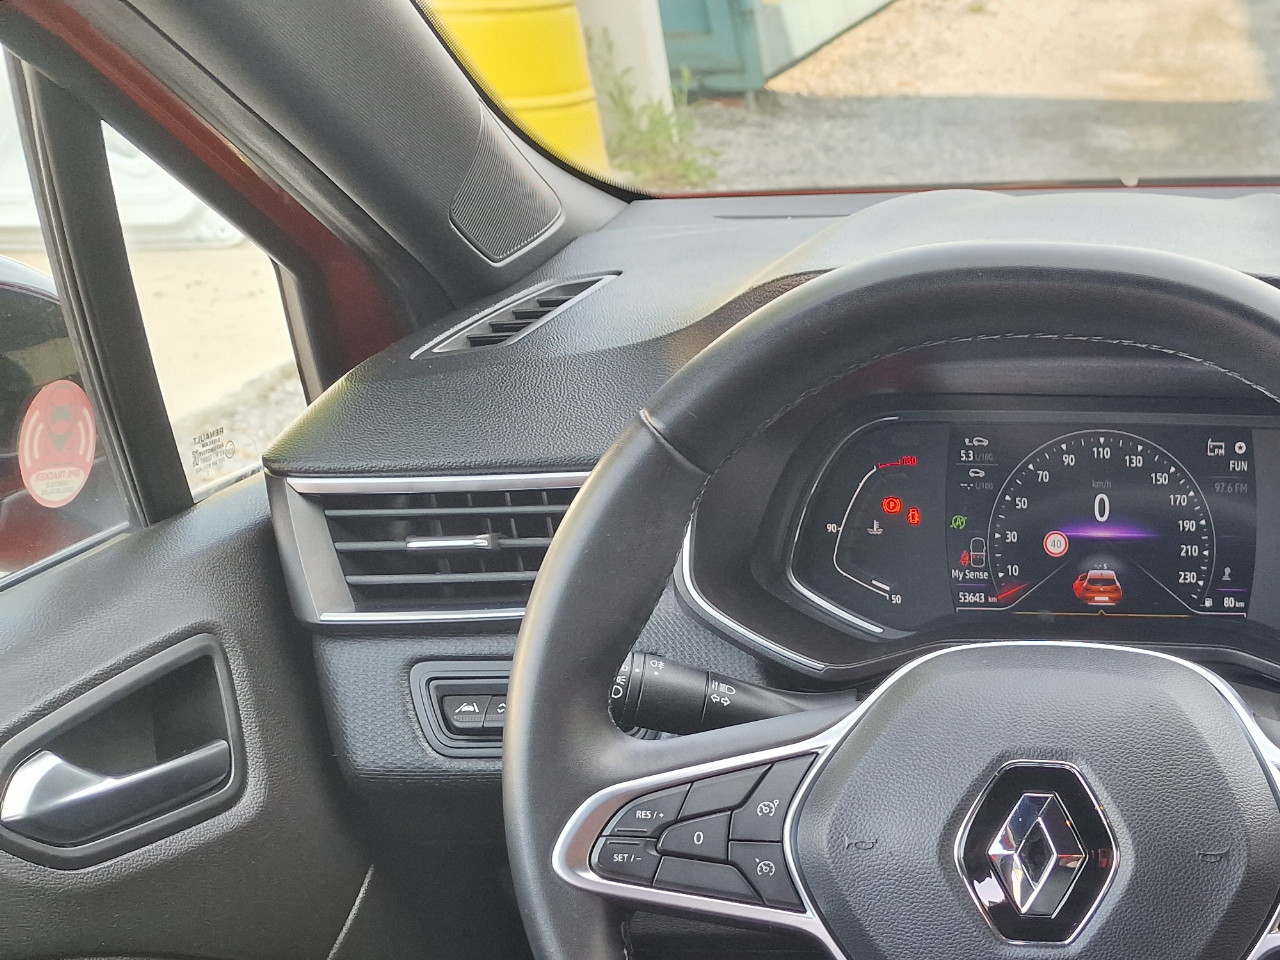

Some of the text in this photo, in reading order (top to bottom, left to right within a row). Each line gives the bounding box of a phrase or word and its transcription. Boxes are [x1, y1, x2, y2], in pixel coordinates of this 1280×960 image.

[1092, 447, 1111, 459] 110
[1062, 454, 1075, 466] 90
[1124, 456, 1143, 467] 130
[1229, 460, 1248, 471] FUN
[1037, 471, 1050, 482] 70
[1150, 473, 1169, 485] 150
[1092, 480, 1112, 489] km/h
[1234, 482, 1248, 493] FM
[1015, 498, 1028, 509] 50
[1169, 495, 1187, 506] 170
[1094, 493, 1110, 522] 0
[826, 523, 837, 533] 90
[1178, 520, 1196, 532] 190
[1005, 532, 1018, 542] 30
[1050, 539, 1062, 549] 40
[1180, 545, 1198, 557] 210
[951, 568, 988, 580] My Sense
[1007, 565, 1019, 576] 10
[1178, 572, 1197, 583] 230
[891, 594, 902, 604] 50
[958, 592, 985, 603] 53643
[1223, 597, 1245, 608] 80 km
[636, 810, 652, 820] RES
[693, 831, 704, 845] 0
[613, 853, 629, 863] SET
